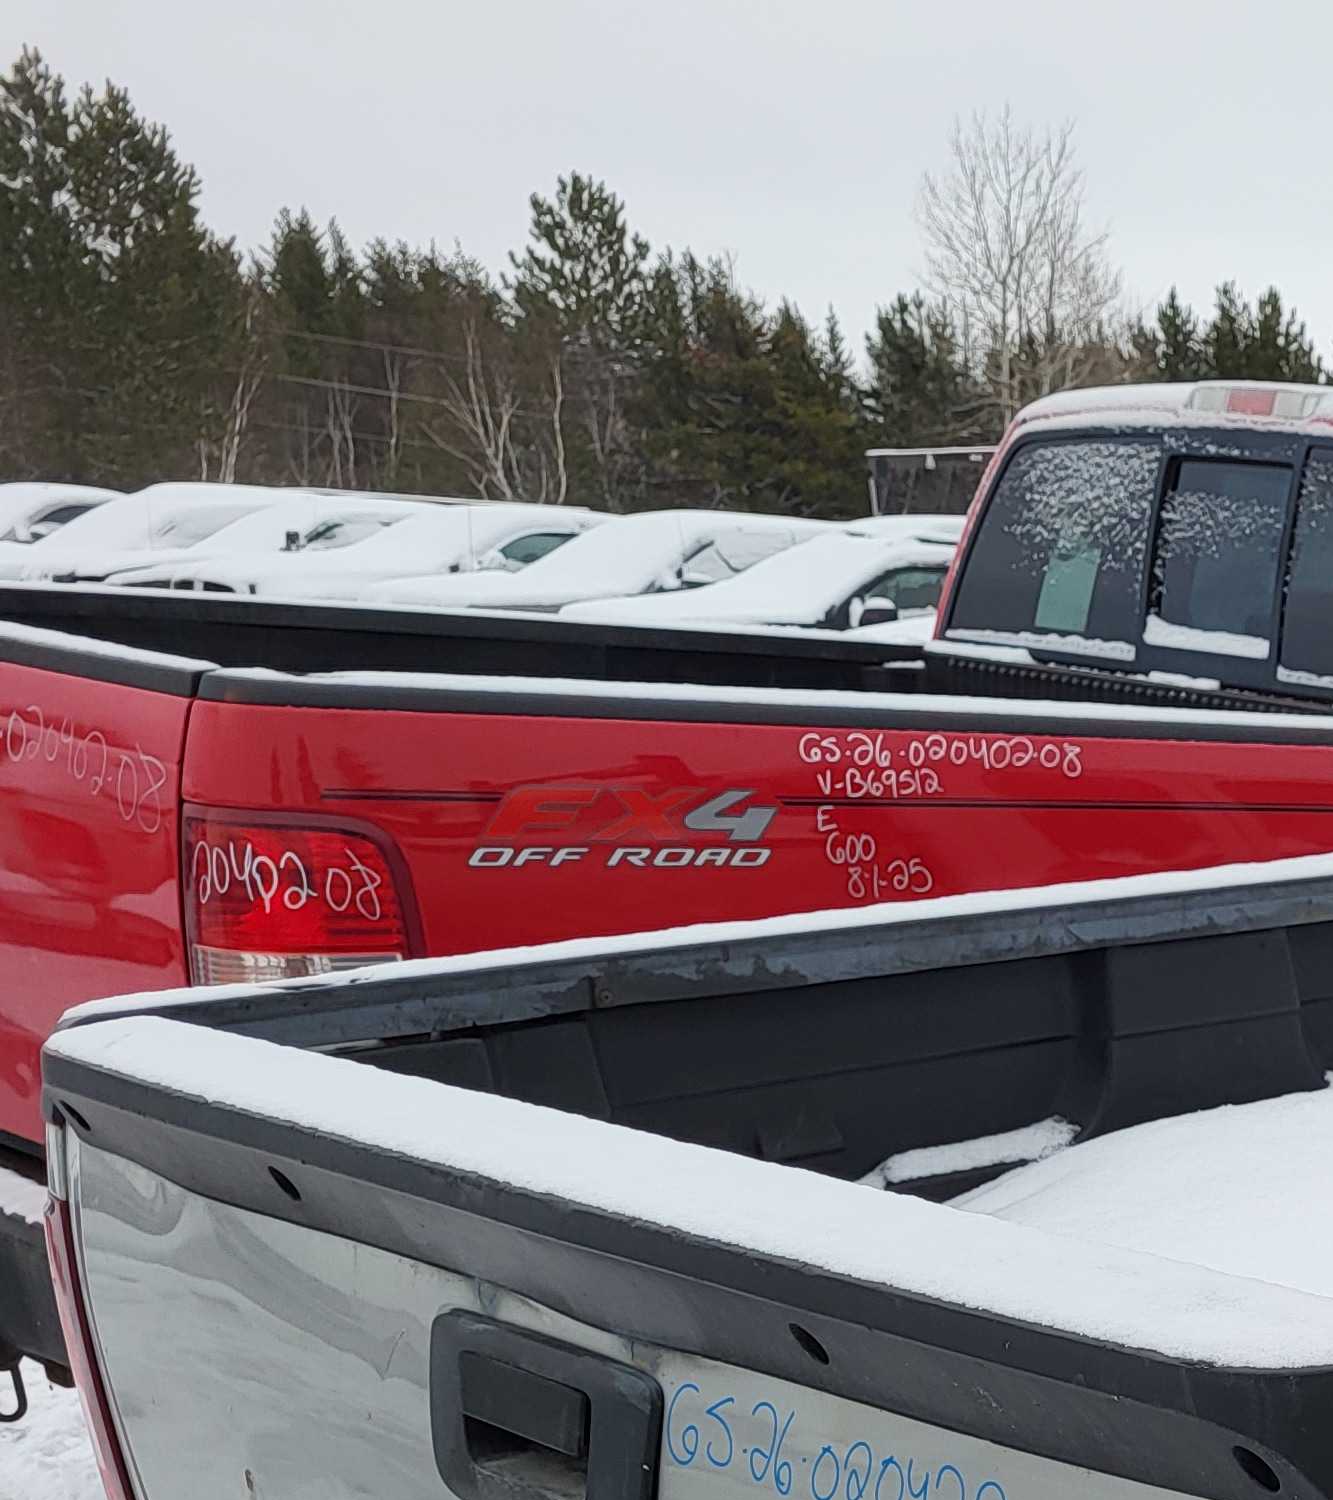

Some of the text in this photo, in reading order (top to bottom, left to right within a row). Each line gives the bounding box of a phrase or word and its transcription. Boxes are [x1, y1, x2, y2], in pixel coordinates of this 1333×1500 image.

[478, 784, 780, 842] FX4
[816, 804, 837, 832] E
[468, 847, 771, 868] OFF ROAD
[826, 831, 877, 864] 600
